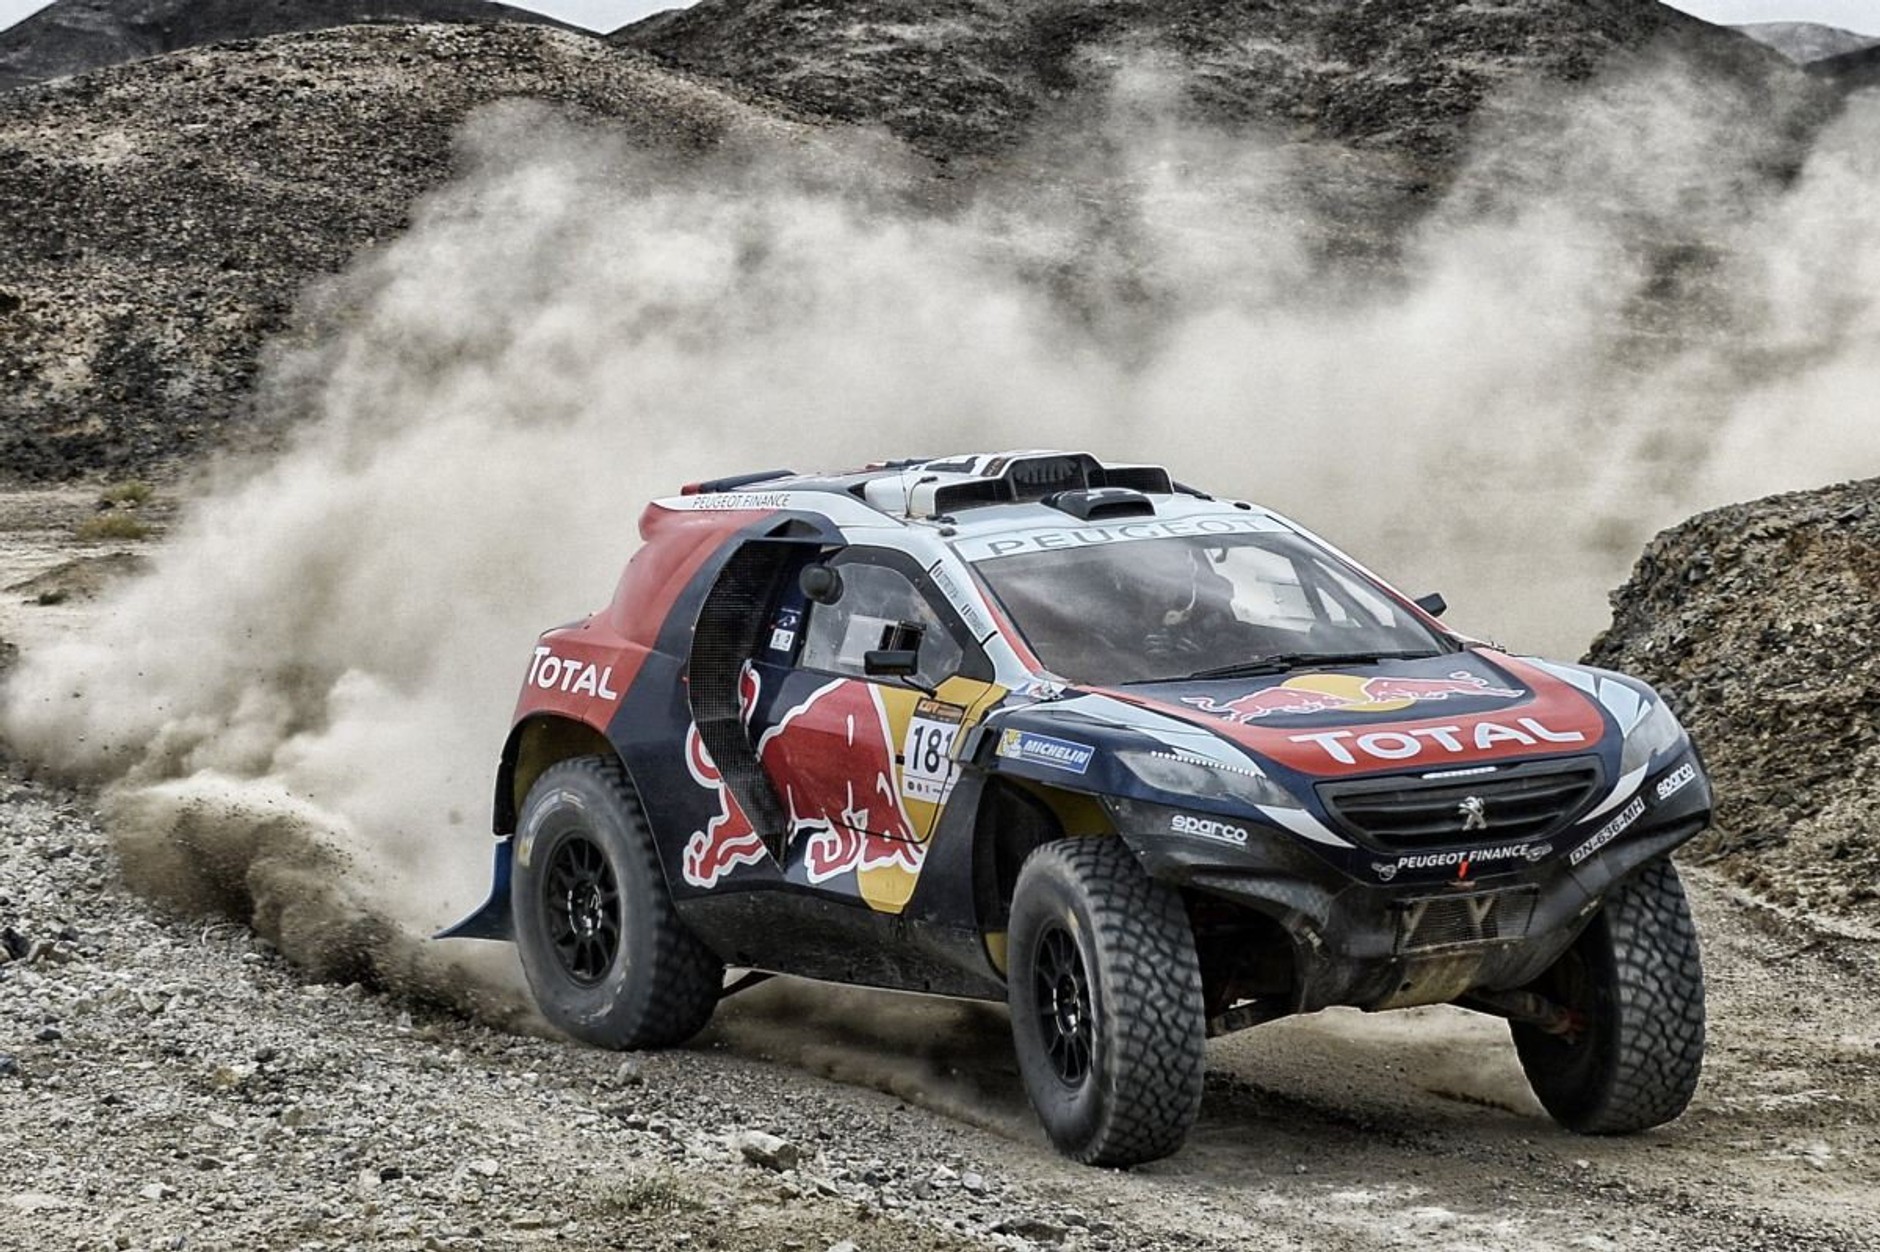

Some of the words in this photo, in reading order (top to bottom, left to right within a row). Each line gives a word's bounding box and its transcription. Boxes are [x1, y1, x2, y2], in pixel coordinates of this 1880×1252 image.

[693, 495, 742, 509] PEUGEOT
[742, 493, 791, 508] FINANCE
[988, 519, 1263, 556] PEUGEOT
[528, 646, 618, 700] TOTAL
[911, 725, 955, 777] 181
[1023, 740, 1089, 764] MICHELIN
[1288, 717, 1585, 764] TOTAL
[1656, 763, 1694, 797] sparco
[1172, 814, 1248, 841] sparco
[1572, 799, 1644, 862] DN-636-MH
[1398, 852, 1468, 870] PEUGEOT
[1469, 844, 1530, 863] FINANCE
